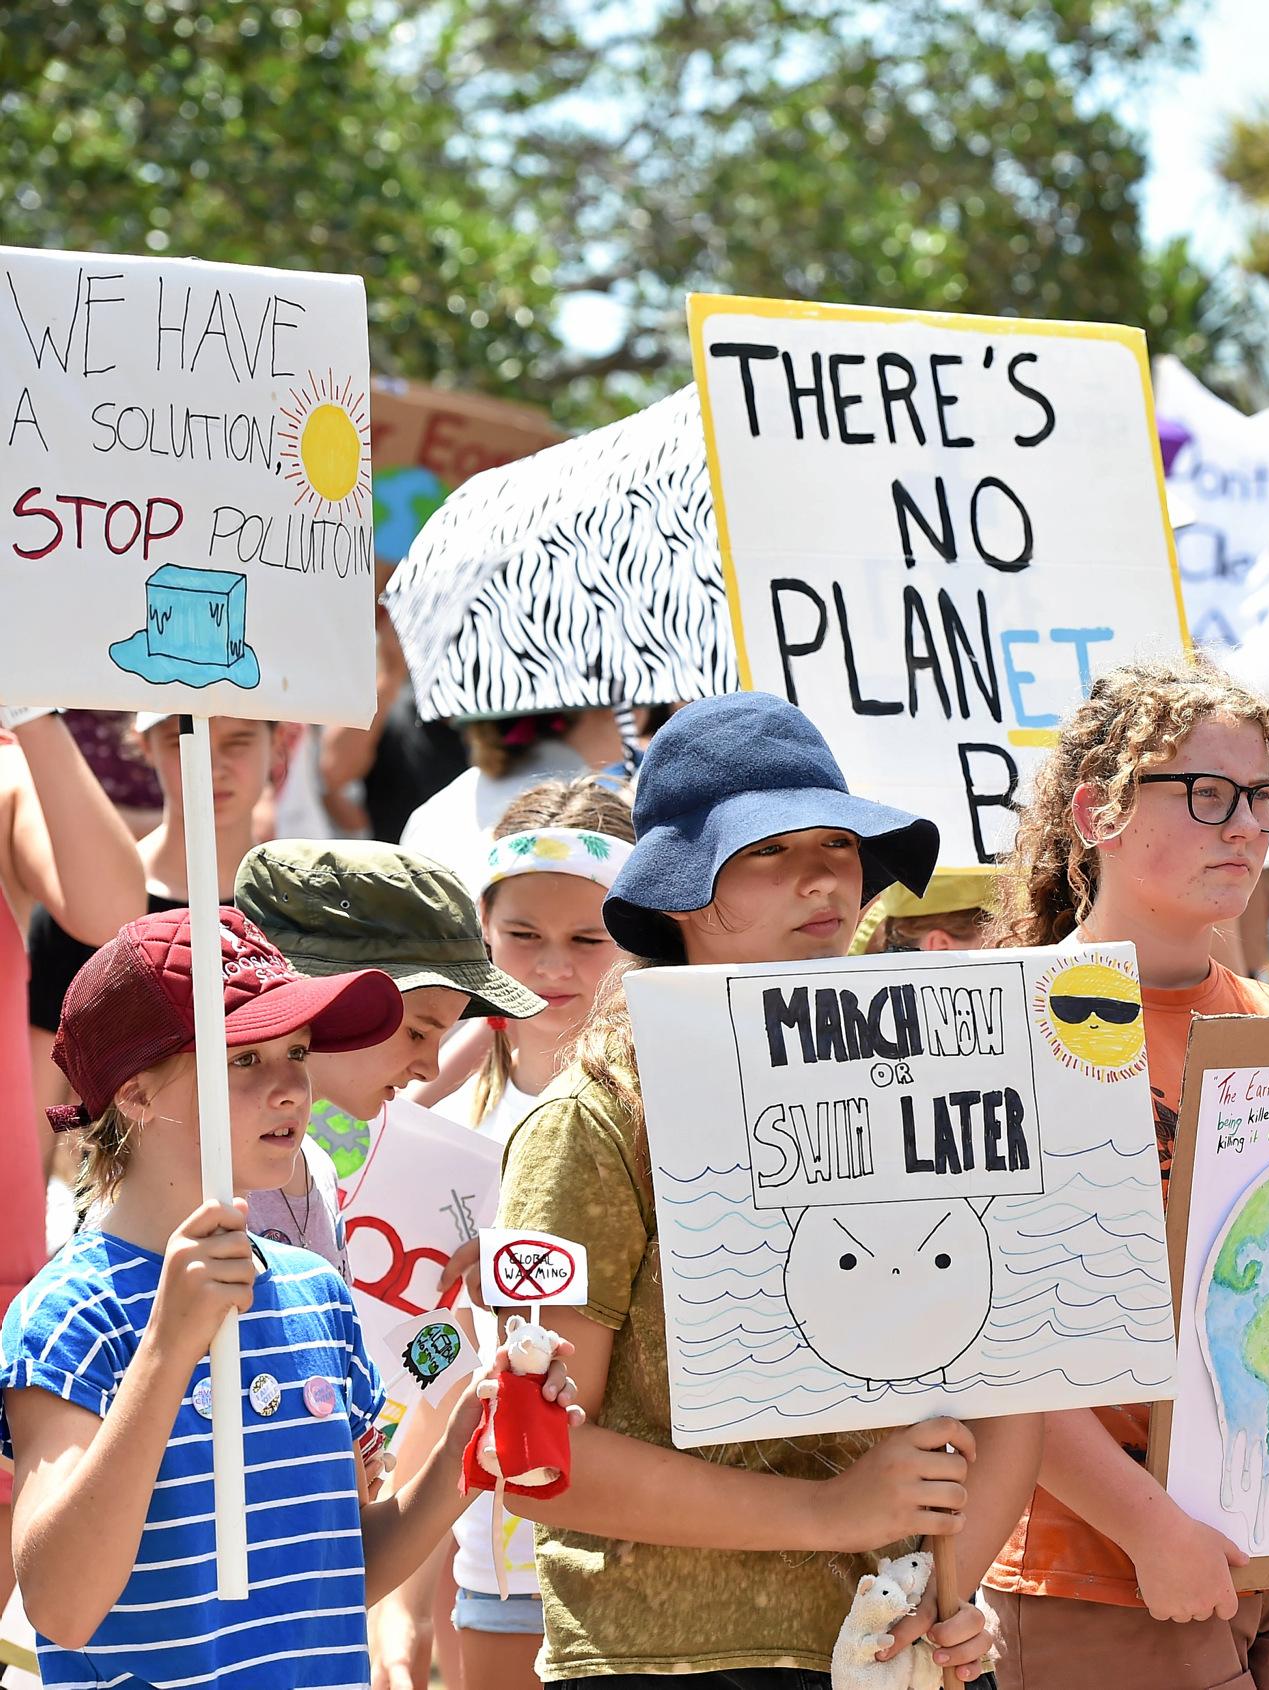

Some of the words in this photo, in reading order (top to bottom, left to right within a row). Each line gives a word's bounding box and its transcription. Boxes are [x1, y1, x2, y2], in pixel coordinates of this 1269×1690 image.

[7, 268, 125, 377] WE
[158, 276, 306, 382] HAVE
[9, 388, 48, 451] A
[92, 403, 282, 475] SOLUTION,
[710, 343, 1055, 448] THERE'S
[13, 487, 184, 560] STOP
[892, 476, 1034, 572] NO
[771, 578, 1114, 728] PLANET
[958, 742, 1023, 865] B
[763, 984, 924, 1067] MARCH
[921, 986, 1004, 1056] NOW
[871, 1062, 914, 1087] OR
[754, 1098, 874, 1188] SWIM
[900, 1087, 1030, 1174] LATER
[1217, 1112, 1242, 1136] being
[1217, 1135, 1245, 1154] killing
[1249, 1130, 1258, 1143] it
[504, 1267, 567, 1279] WAMING
